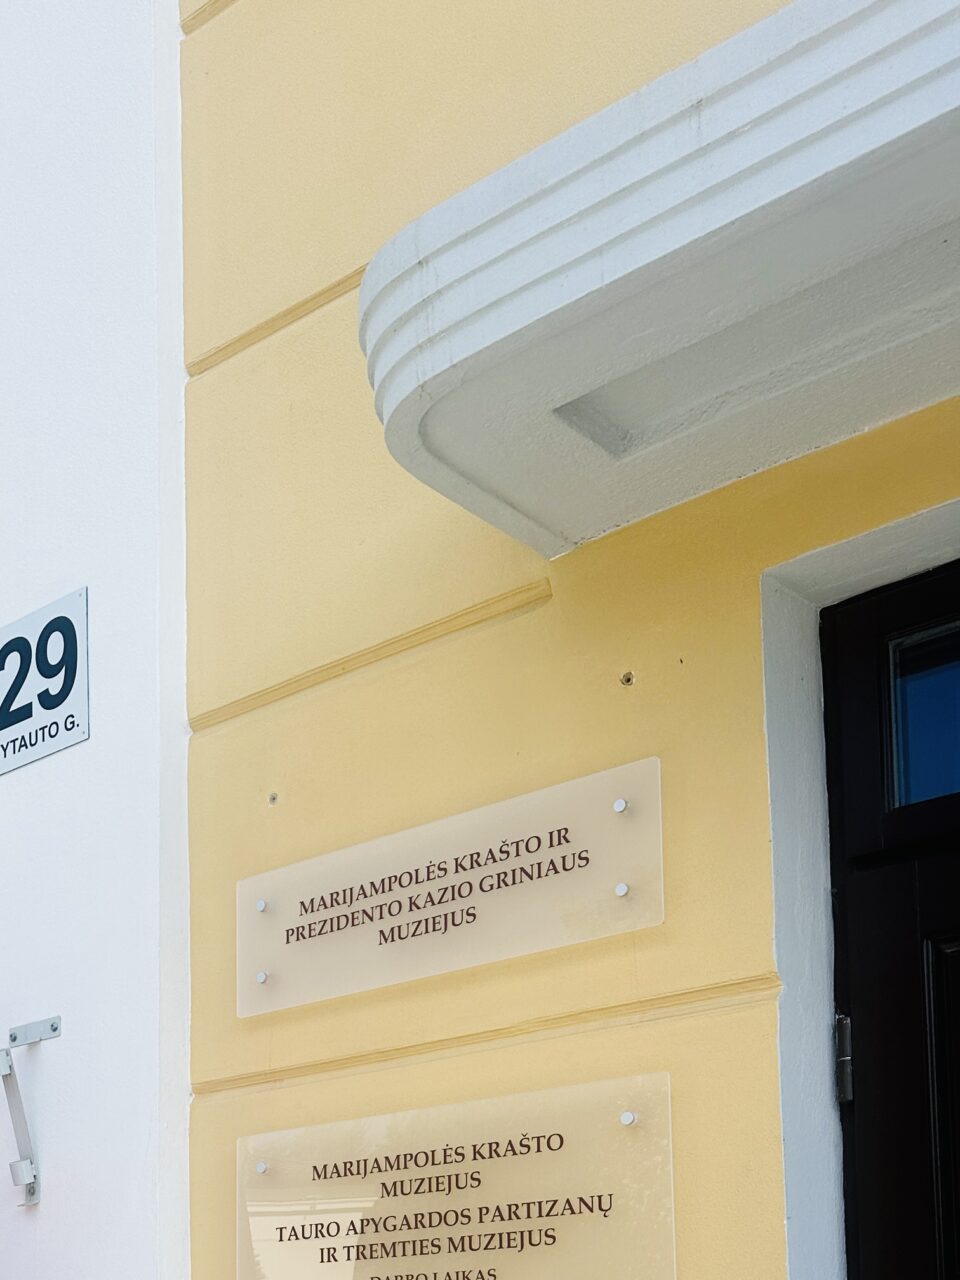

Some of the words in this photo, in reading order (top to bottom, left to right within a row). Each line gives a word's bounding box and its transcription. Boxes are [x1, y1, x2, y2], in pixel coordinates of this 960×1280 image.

[64, 713, 80, 732] G.
[298, 860, 448, 917] MARIJAMPOLĖS
[453, 838, 542, 875] KRAŠTO
[547, 827, 571, 849] IR
[285, 900, 402, 944] PREZIDENTO
[408, 881, 473, 912] KAZIO
[479, 849, 590, 893] GRINIAUS
[378, 906, 477, 945] MUZIEJUS
[311, 1143, 465, 1181] MARIJAMPOLĖS
[471, 1132, 565, 1161] KRAŠTO
[380, 1171, 482, 1199] MUZIEJUS
[276, 1221, 340, 1242] TAURO
[345, 1208, 472, 1236] APYGARDOS
[477, 1193, 614, 1224] PARTIZANŲ
[319, 1247, 338, 1263] IR
[342, 1237, 442, 1261] TREMTIES
[447, 1227, 557, 1253] MUZIEJUS
